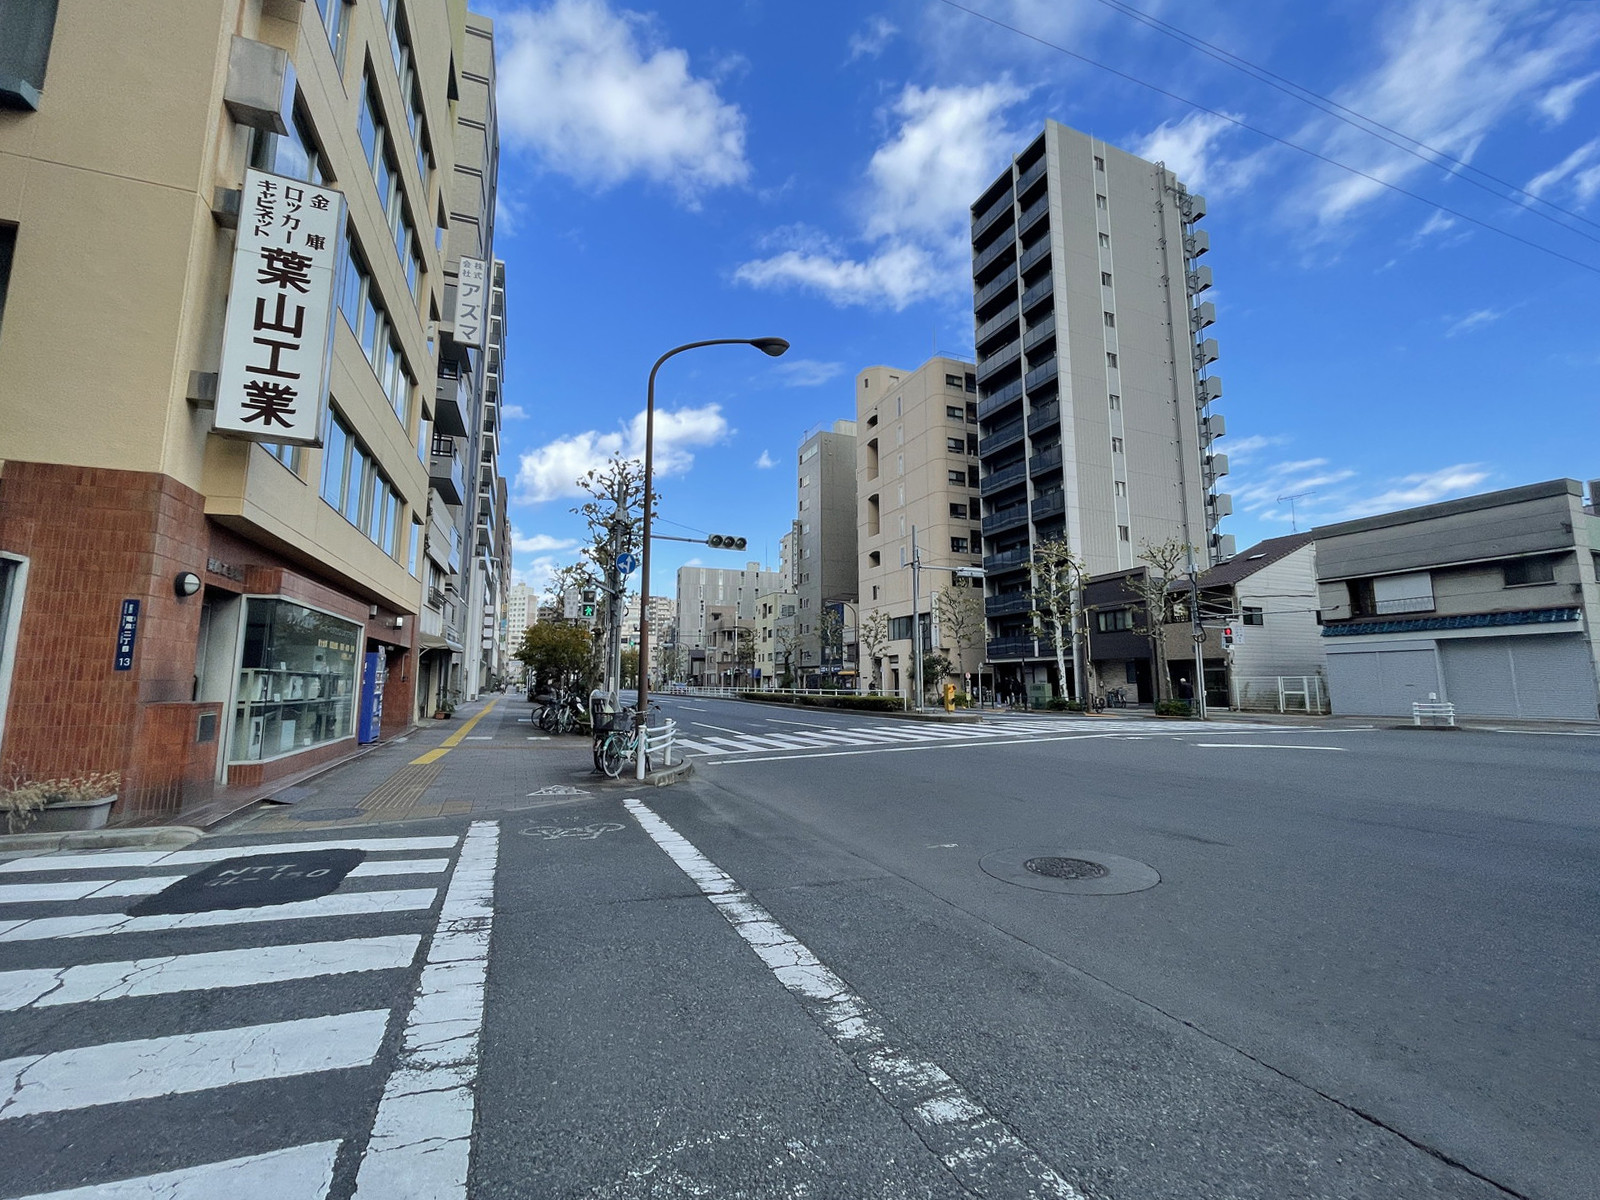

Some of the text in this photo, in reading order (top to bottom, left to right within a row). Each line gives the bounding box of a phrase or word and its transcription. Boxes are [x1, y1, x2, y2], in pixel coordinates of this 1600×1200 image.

[253, 180, 277, 237] キャビネット
[281, 186, 304, 244] ロッカー
[305, 194, 330, 251] 金庫
[240, 246, 312, 429] 葉山工業
[459, 282, 480, 340] アズマ
[119, 657, 131, 667] 13
[218, 864, 297, 878] NTT
